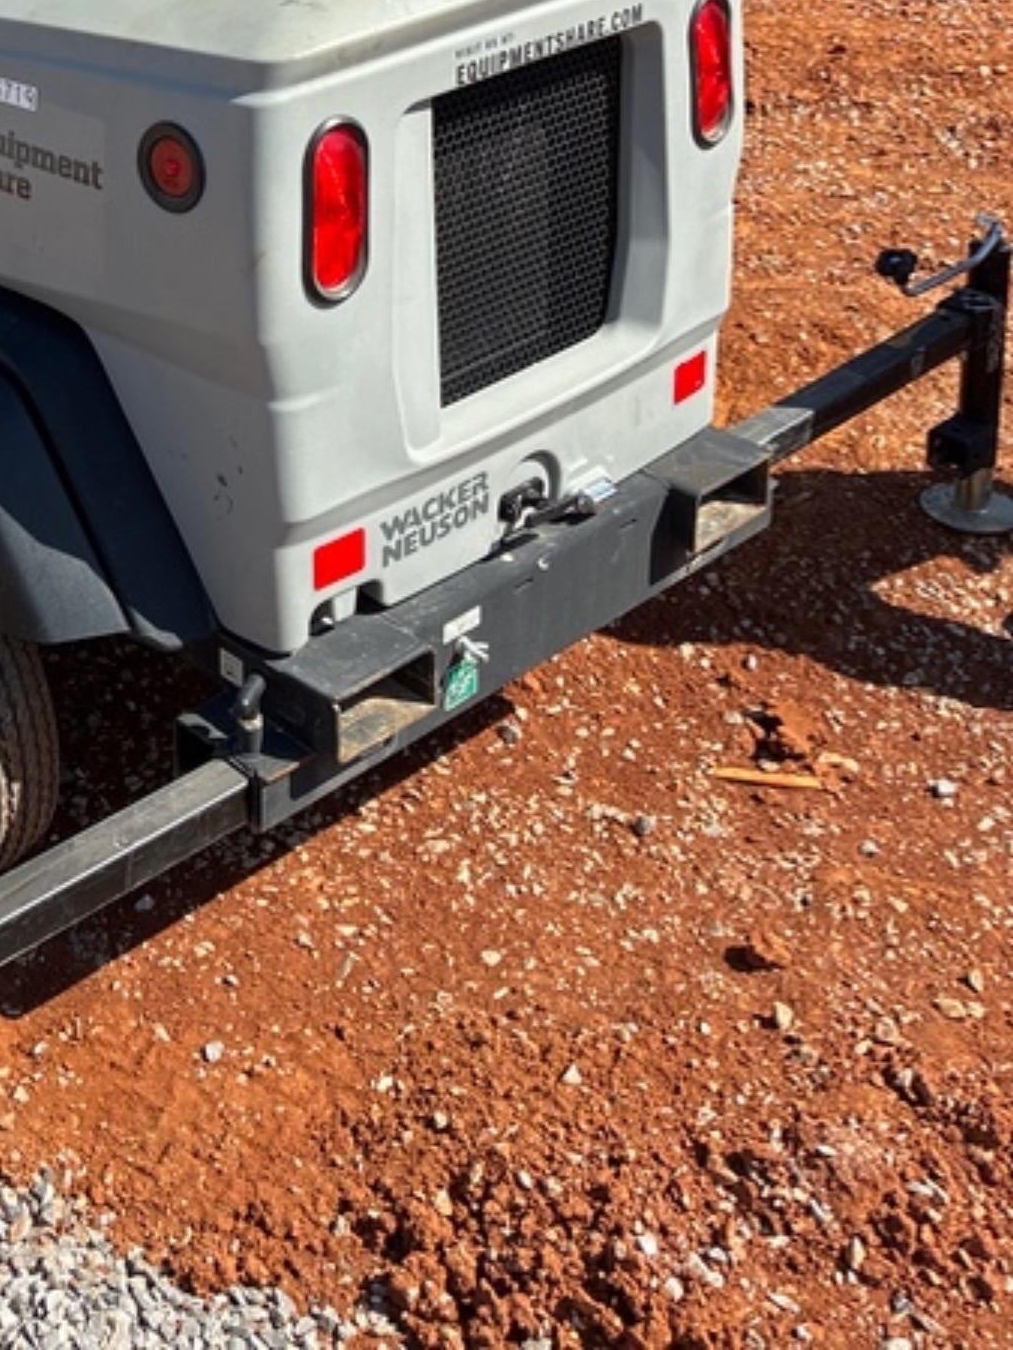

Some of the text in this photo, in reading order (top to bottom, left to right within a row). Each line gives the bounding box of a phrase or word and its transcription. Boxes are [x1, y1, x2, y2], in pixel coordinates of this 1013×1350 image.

[457, 3, 643, 86] EQUIPMENTSHARE.COM
[380, 471, 488, 541] WACKER
[382, 492, 489, 568] NEUSON
